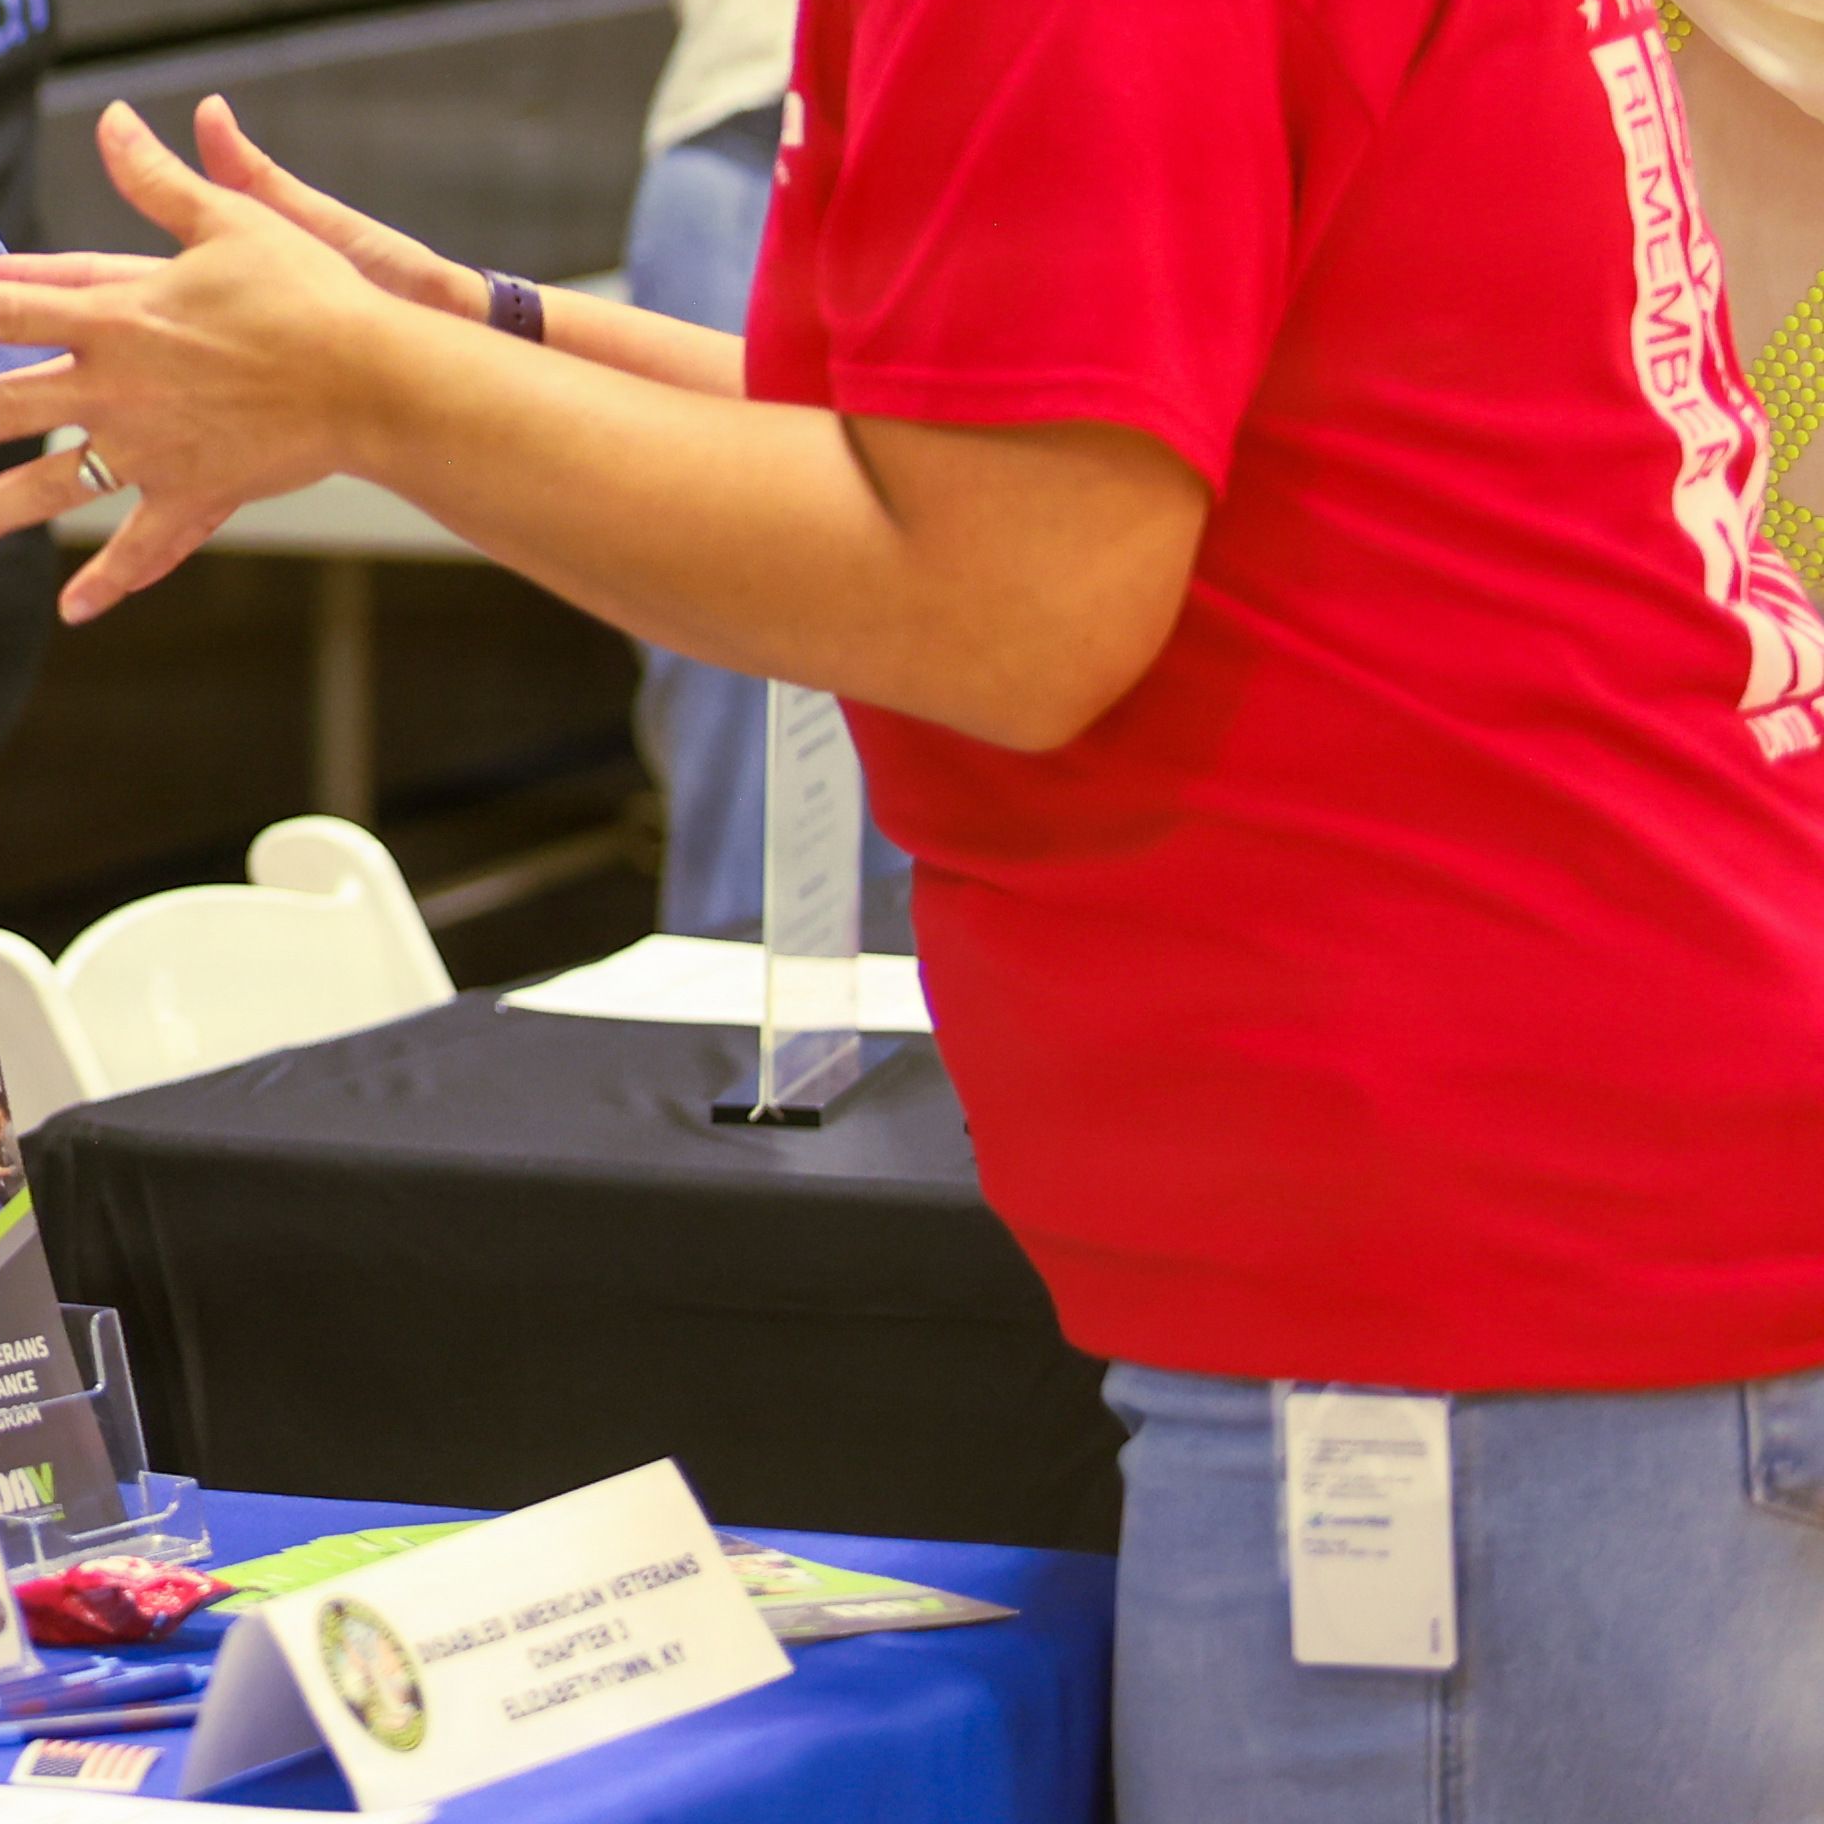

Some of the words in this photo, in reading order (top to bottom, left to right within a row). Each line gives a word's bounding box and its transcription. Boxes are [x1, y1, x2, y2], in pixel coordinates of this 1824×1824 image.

[1614, 64, 1732, 489] REMEMBER
[415, 1616, 507, 1665] DISABLED
[510, 1588, 608, 1633] AMERICAN
[610, 1551, 702, 1601] VETERANS
[526, 1622, 617, 1670] CHAPTER
[659, 1641, 687, 1668] KY
